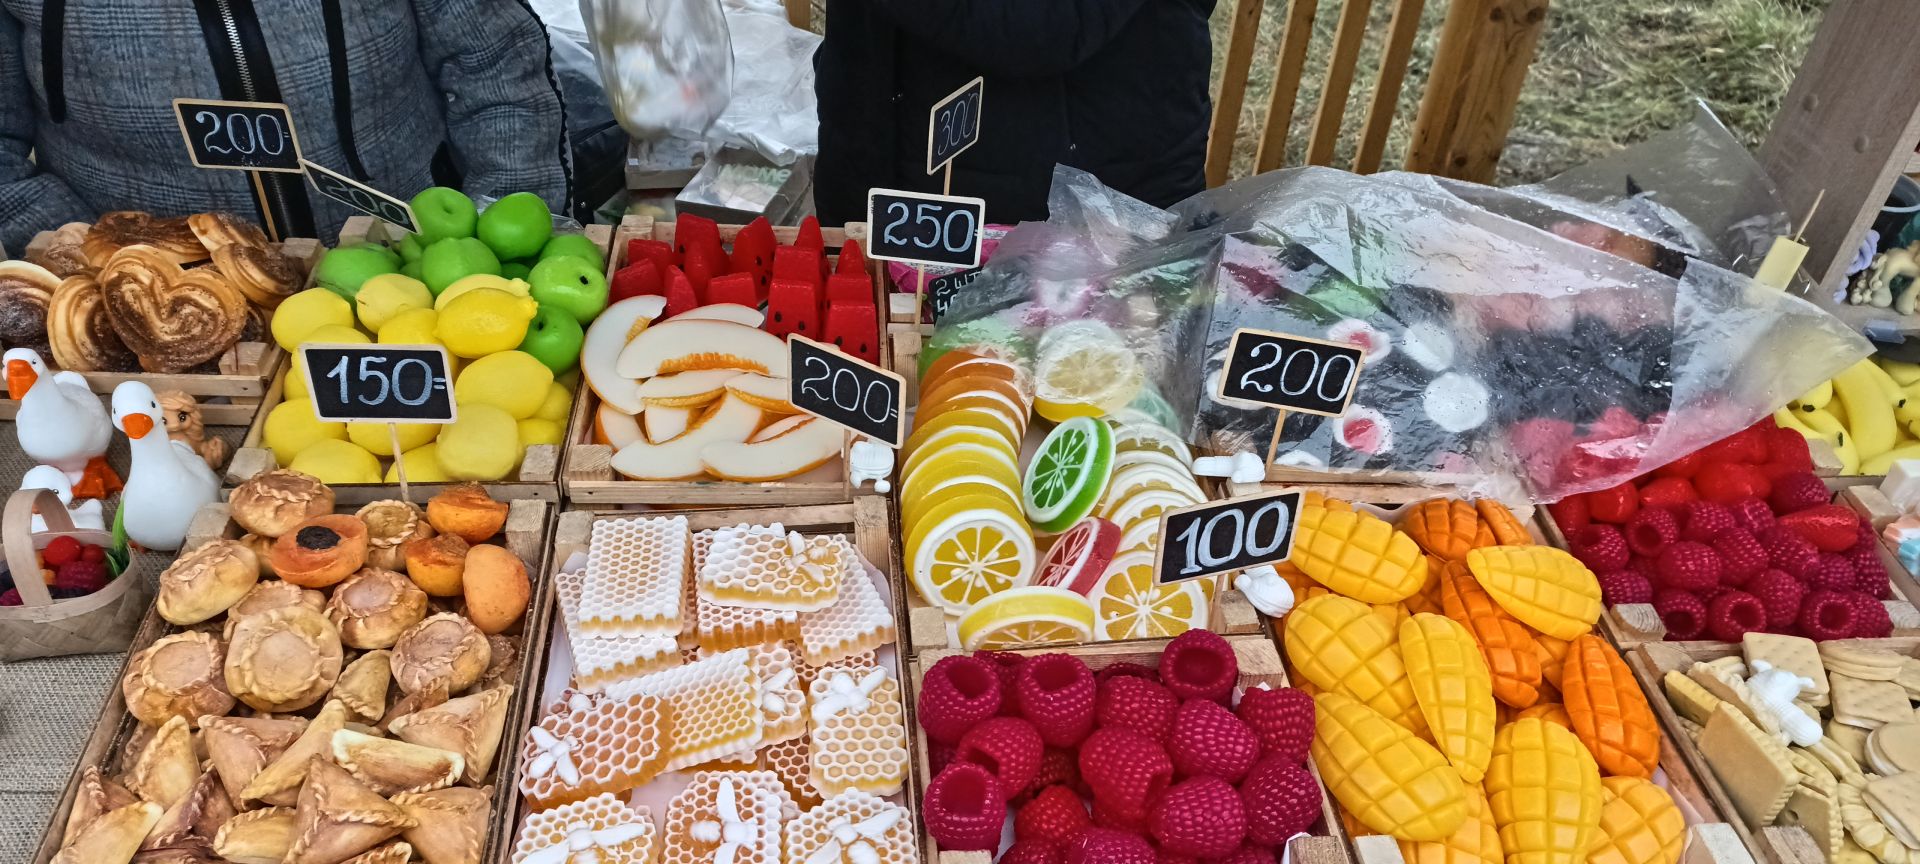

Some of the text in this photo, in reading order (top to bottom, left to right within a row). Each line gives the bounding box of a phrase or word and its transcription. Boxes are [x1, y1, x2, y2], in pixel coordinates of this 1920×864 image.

[938, 92, 979, 155] 300
[320, 173, 410, 225] 200
[936, 279, 951, 296] 2
[1240, 342, 1356, 402] 200
